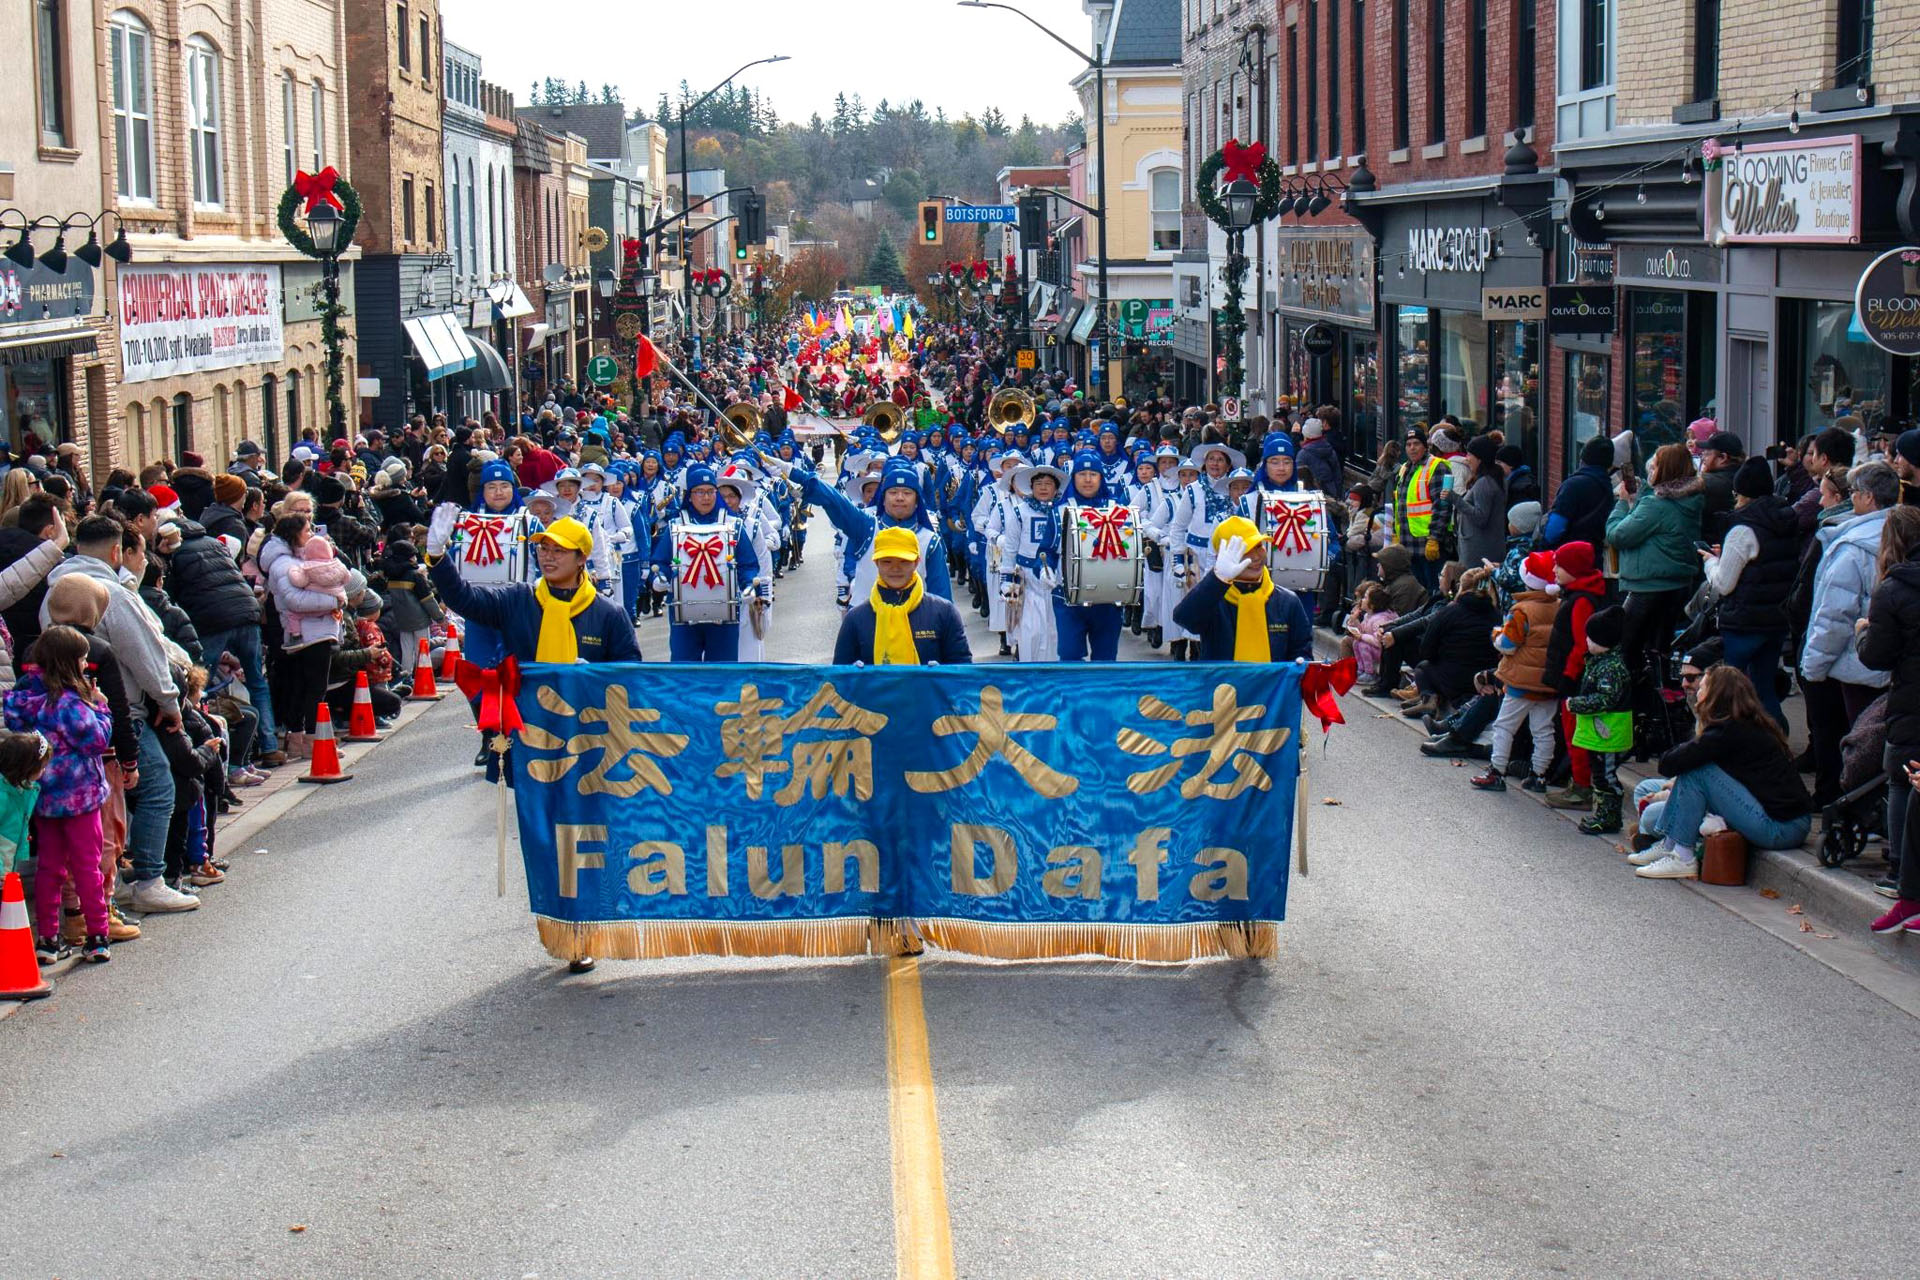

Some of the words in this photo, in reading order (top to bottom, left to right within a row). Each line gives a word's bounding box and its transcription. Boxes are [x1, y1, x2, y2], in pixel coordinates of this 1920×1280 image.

[1727, 154, 1807, 185] BLOOMING
[1810, 153, 1837, 174] Flower,
[1810, 187, 1816, 201] &
[946, 208, 1004, 220] BOTSFORD
[1007, 208, 1014, 216] ST
[1725, 176, 1799, 235] Wellies
[1816, 209, 1850, 232] Boutique
[1316, 240, 1352, 276] VILLAGE
[1409, 228, 1444, 271] MARC
[1446, 227, 1491, 272] GROUP
[1579, 259, 1613, 275] BOUTIQUE
[1646, 258, 1665, 276] OLIVE
[1665, 248, 1680, 278] OIL
[1680, 259, 1691, 278] CO.
[30, 282, 72, 303] PHARMACY
[122, 272, 196, 326] COMMERCIAL
[197, 272, 227, 320] SPACE
[1488, 295, 1542, 309] MARC
[1129, 301, 1142, 316] P
[1551, 307, 1576, 316] OLIVE
[1577, 303, 1597, 316] OIL
[1597, 306, 1613, 316] CO.
[596, 358, 610, 376] P
[1020, 352, 1033, 361] 30
[522, 682, 1291, 807] 法輪大法
[552, 822, 881, 900] Falun
[948, 822, 1250, 903] Dafa
